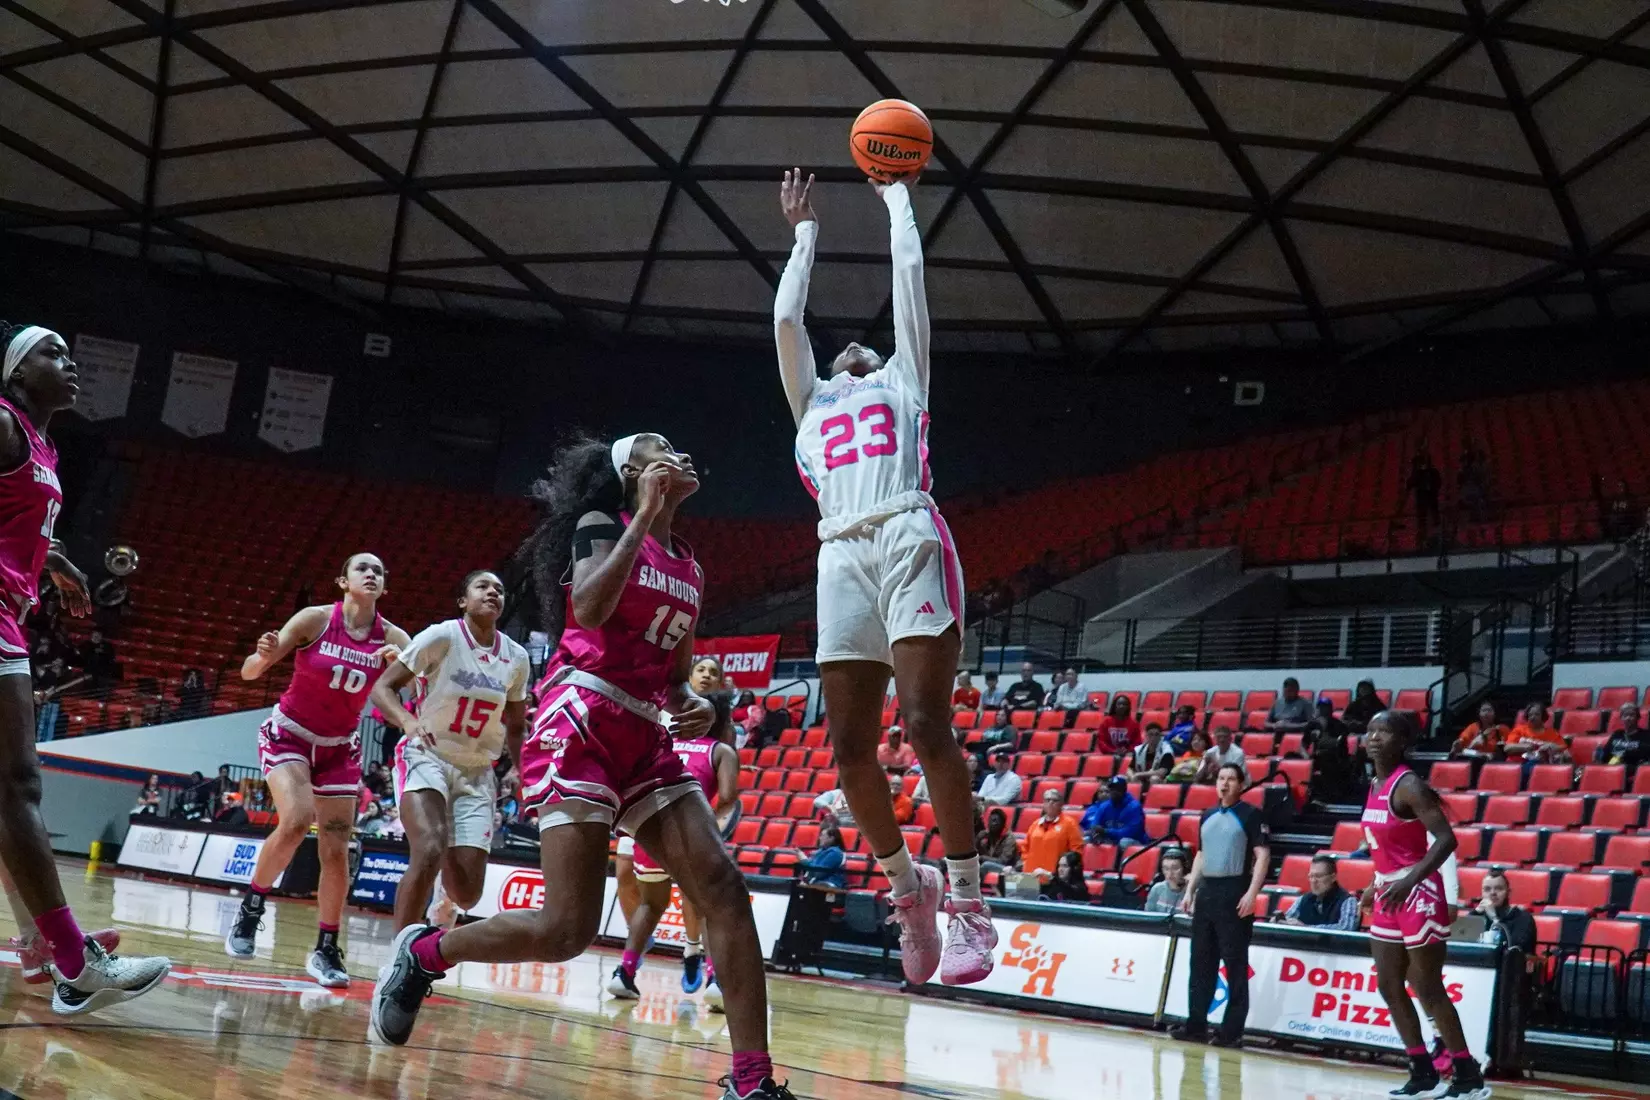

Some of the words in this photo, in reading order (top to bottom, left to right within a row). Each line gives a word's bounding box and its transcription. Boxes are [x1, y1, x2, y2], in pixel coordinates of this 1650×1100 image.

[867, 139, 921, 159] Wilson
[820, 403, 897, 472] 23
[638, 565, 666, 593] SAM
[668, 576, 699, 608] HOUST
[644, 605, 693, 650] 15
[319, 641, 342, 658] SAM
[723, 652, 769, 672] CREW
[329, 664, 367, 694] 10
[449, 697, 498, 738] 15
[234, 843, 256, 860] BUD
[363, 857, 374, 868] The
[224, 859, 256, 877] LIGHT
[1279, 957, 1464, 1003] Domis
[1312, 992, 1392, 1027] Pizz
[1288, 1020, 1316, 1032] Order
[1318, 1024, 1351, 1037] Online
